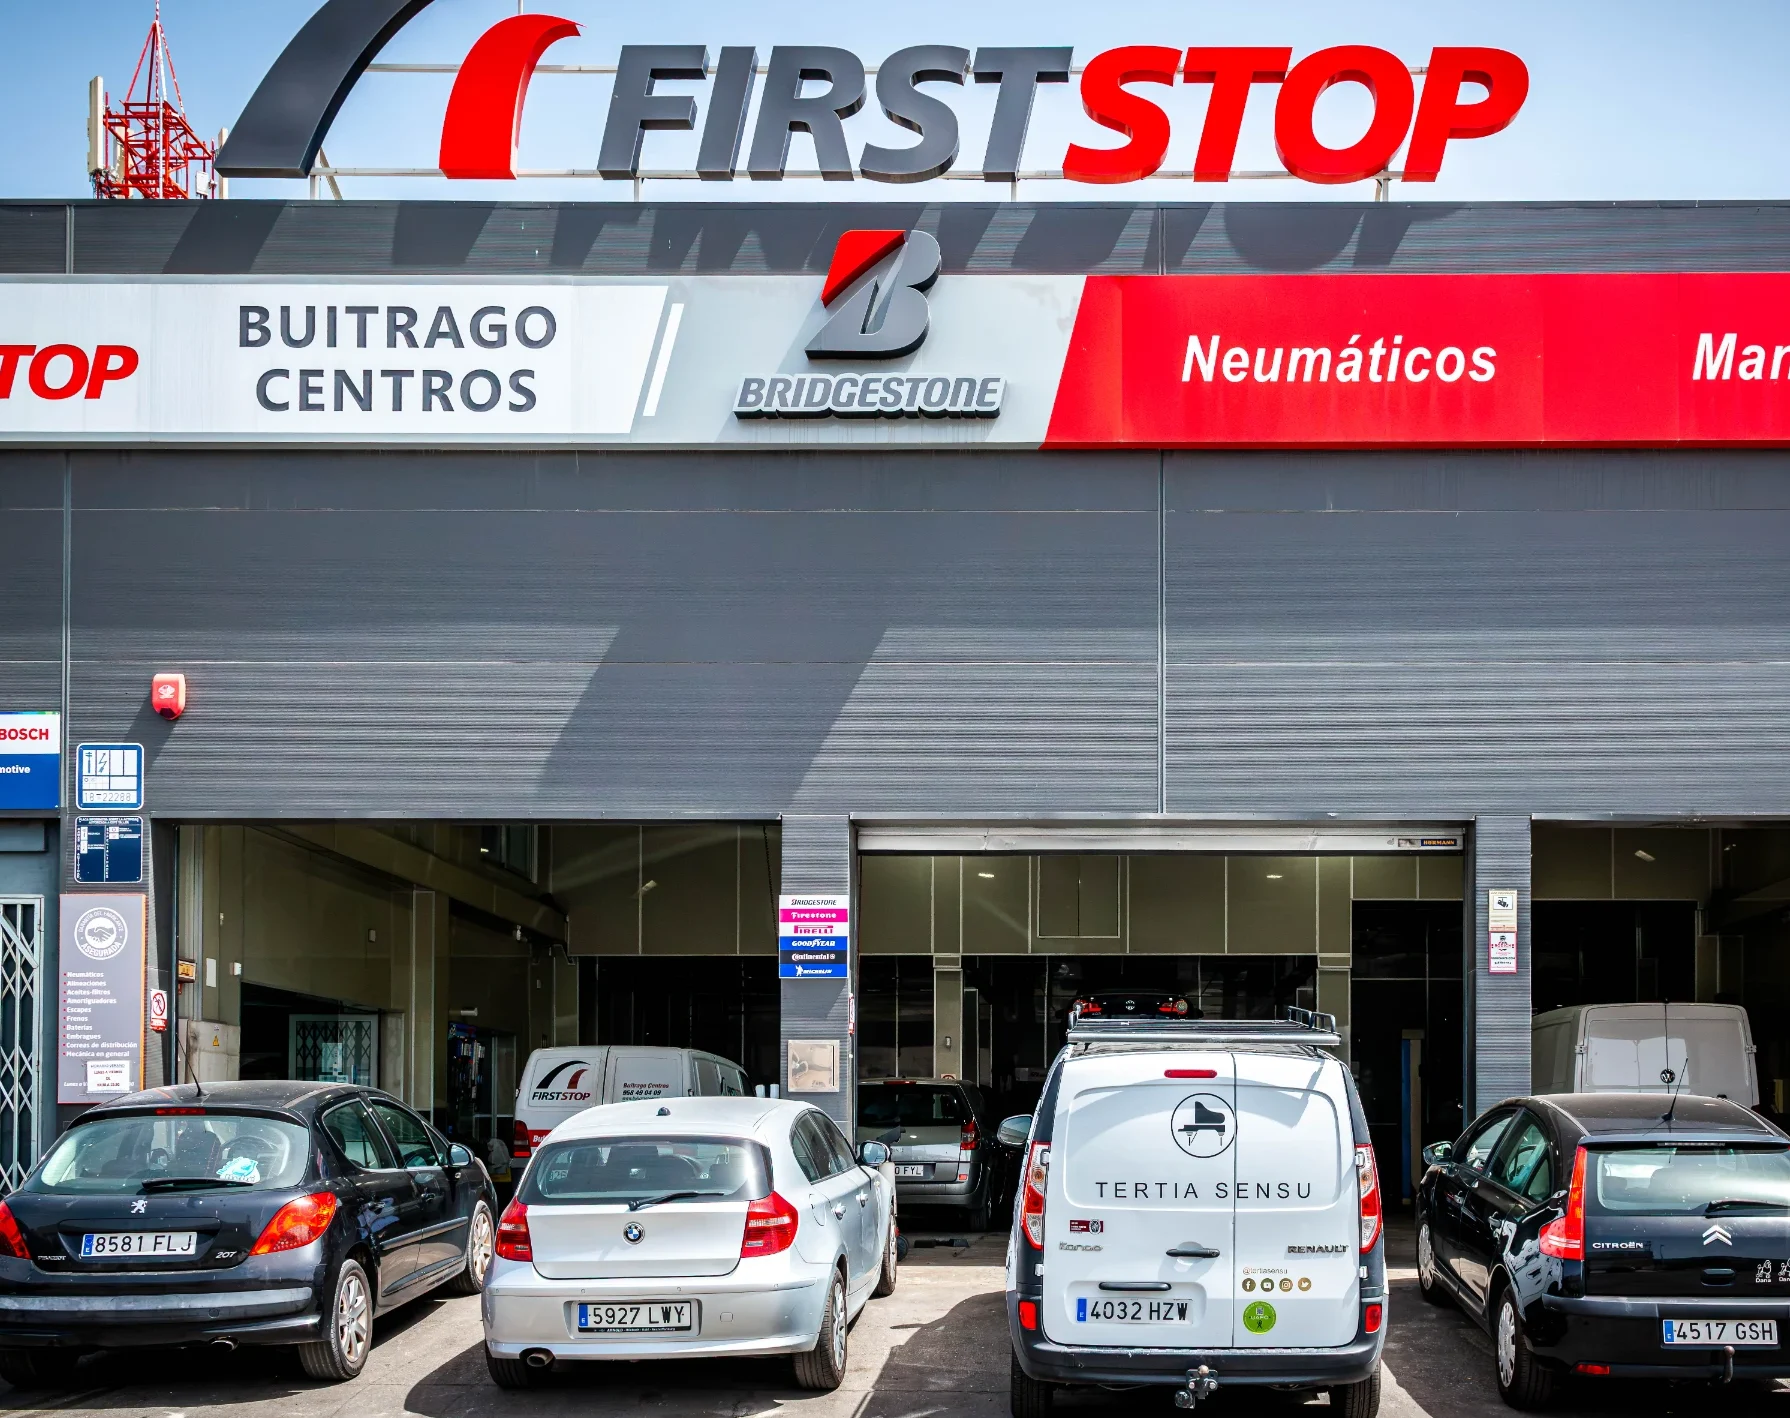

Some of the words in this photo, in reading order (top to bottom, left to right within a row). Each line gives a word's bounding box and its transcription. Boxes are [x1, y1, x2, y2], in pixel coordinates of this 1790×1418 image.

[239, 305, 557, 348] BUITRAGO
[1181, 334, 1497, 383] Neumáticos
[256, 368, 537, 412] CENTROS
[735, 375, 1003, 411] BRIDGESTONE
[0, 728, 49, 741] BOSCH
[791, 912, 837, 920] Firestone
[793, 925, 834, 934] PIRELLI
[81, 941, 122, 957] ASEGURADA
[791, 938, 836, 948] GOODYEAR
[791, 953, 829, 961] Continental
[532, 1091, 591, 1101] FIRSTSTOP
[904, 1166, 922, 1176] FYL
[1095, 1181, 1198, 1199] TERTIA
[1215, 1182, 1311, 1199] SENSU
[94, 1235, 145, 1253] 8581
[153, 1234, 192, 1252] FLJ
[1287, 1244, 1349, 1254] RENAULT
[1592, 1241, 1644, 1249] CITROËN
[215, 1250, 237, 1259] 207
[593, 1307, 641, 1325] 5927
[648, 1305, 685, 1324] LWY
[1090, 1301, 1142, 1320] 4032
[1149, 1301, 1188, 1321] HZW
[1676, 1322, 1727, 1340] 4517
[1735, 1322, 1774, 1341] GSH
